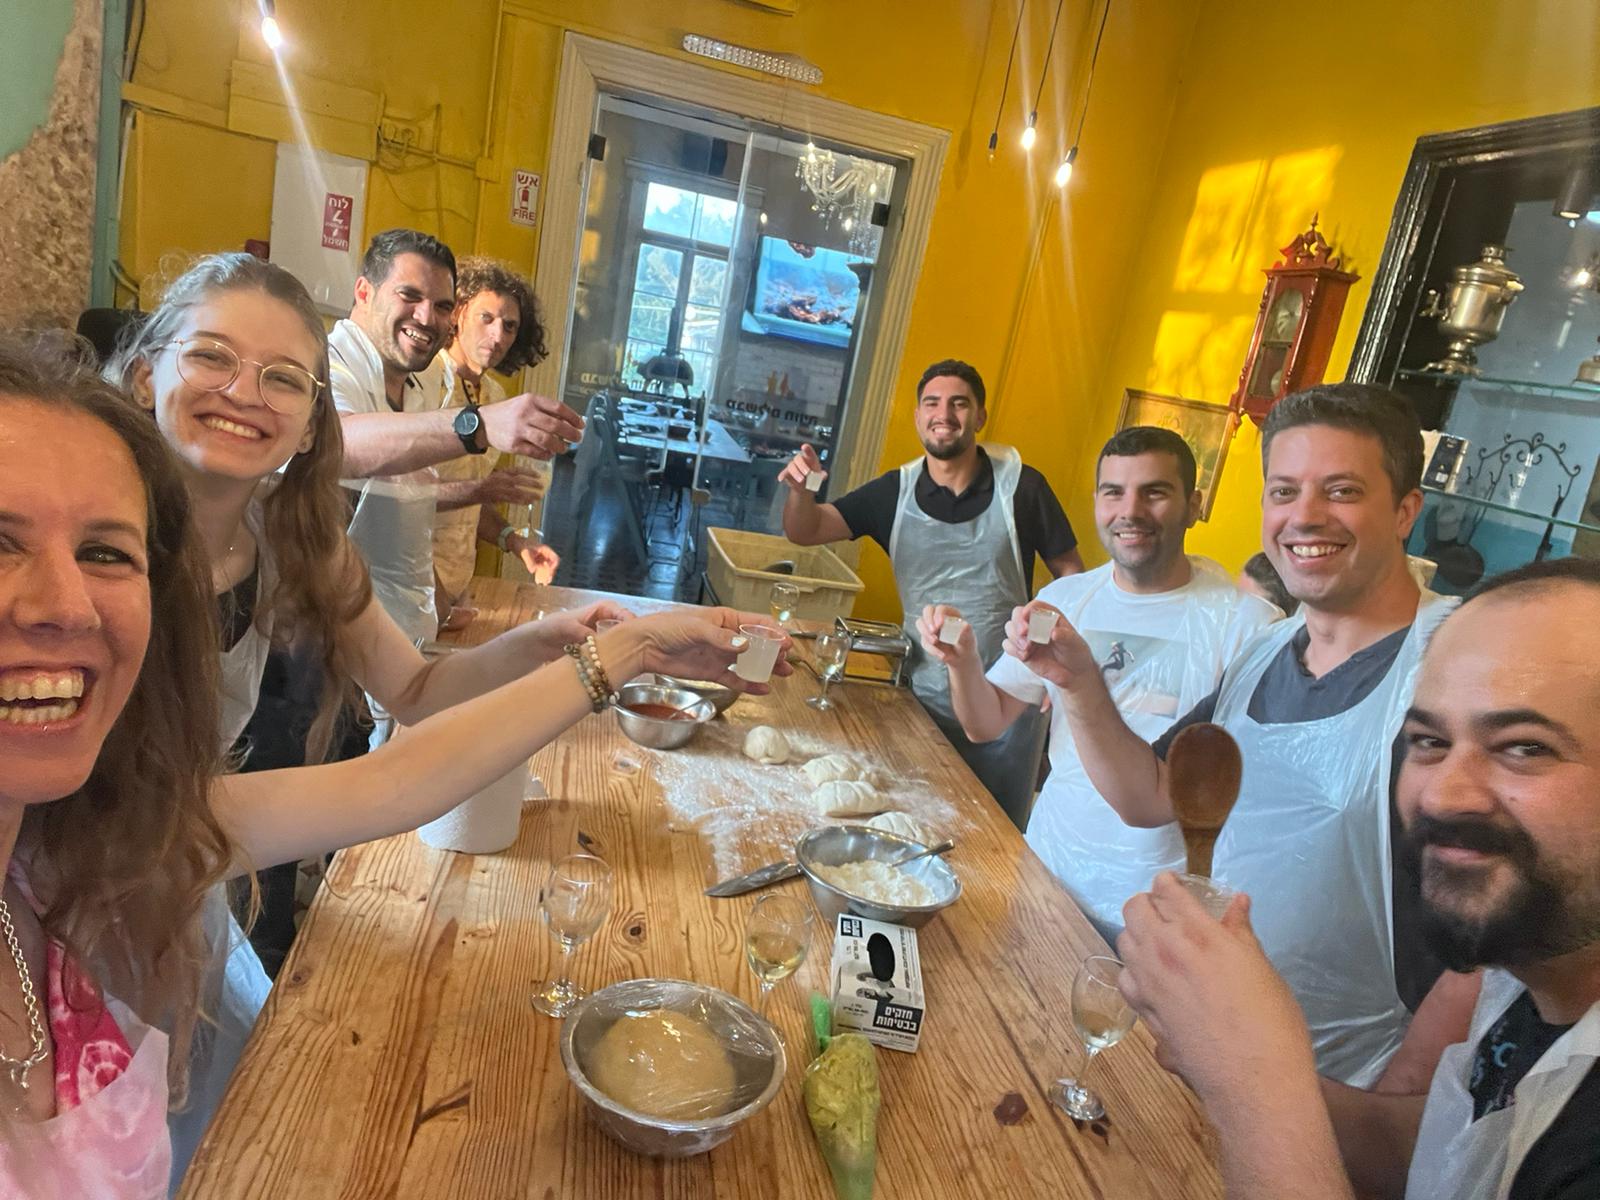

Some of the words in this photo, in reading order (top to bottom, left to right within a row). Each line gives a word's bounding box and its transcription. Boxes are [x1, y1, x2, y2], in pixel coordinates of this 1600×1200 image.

[517, 174, 538, 187] אש
[329, 197, 349, 209] לוח
[513, 208, 536, 221] FIRE
[884, 1005, 913, 1020] חזקים
[875, 1016, 917, 1031] בבטיחות
